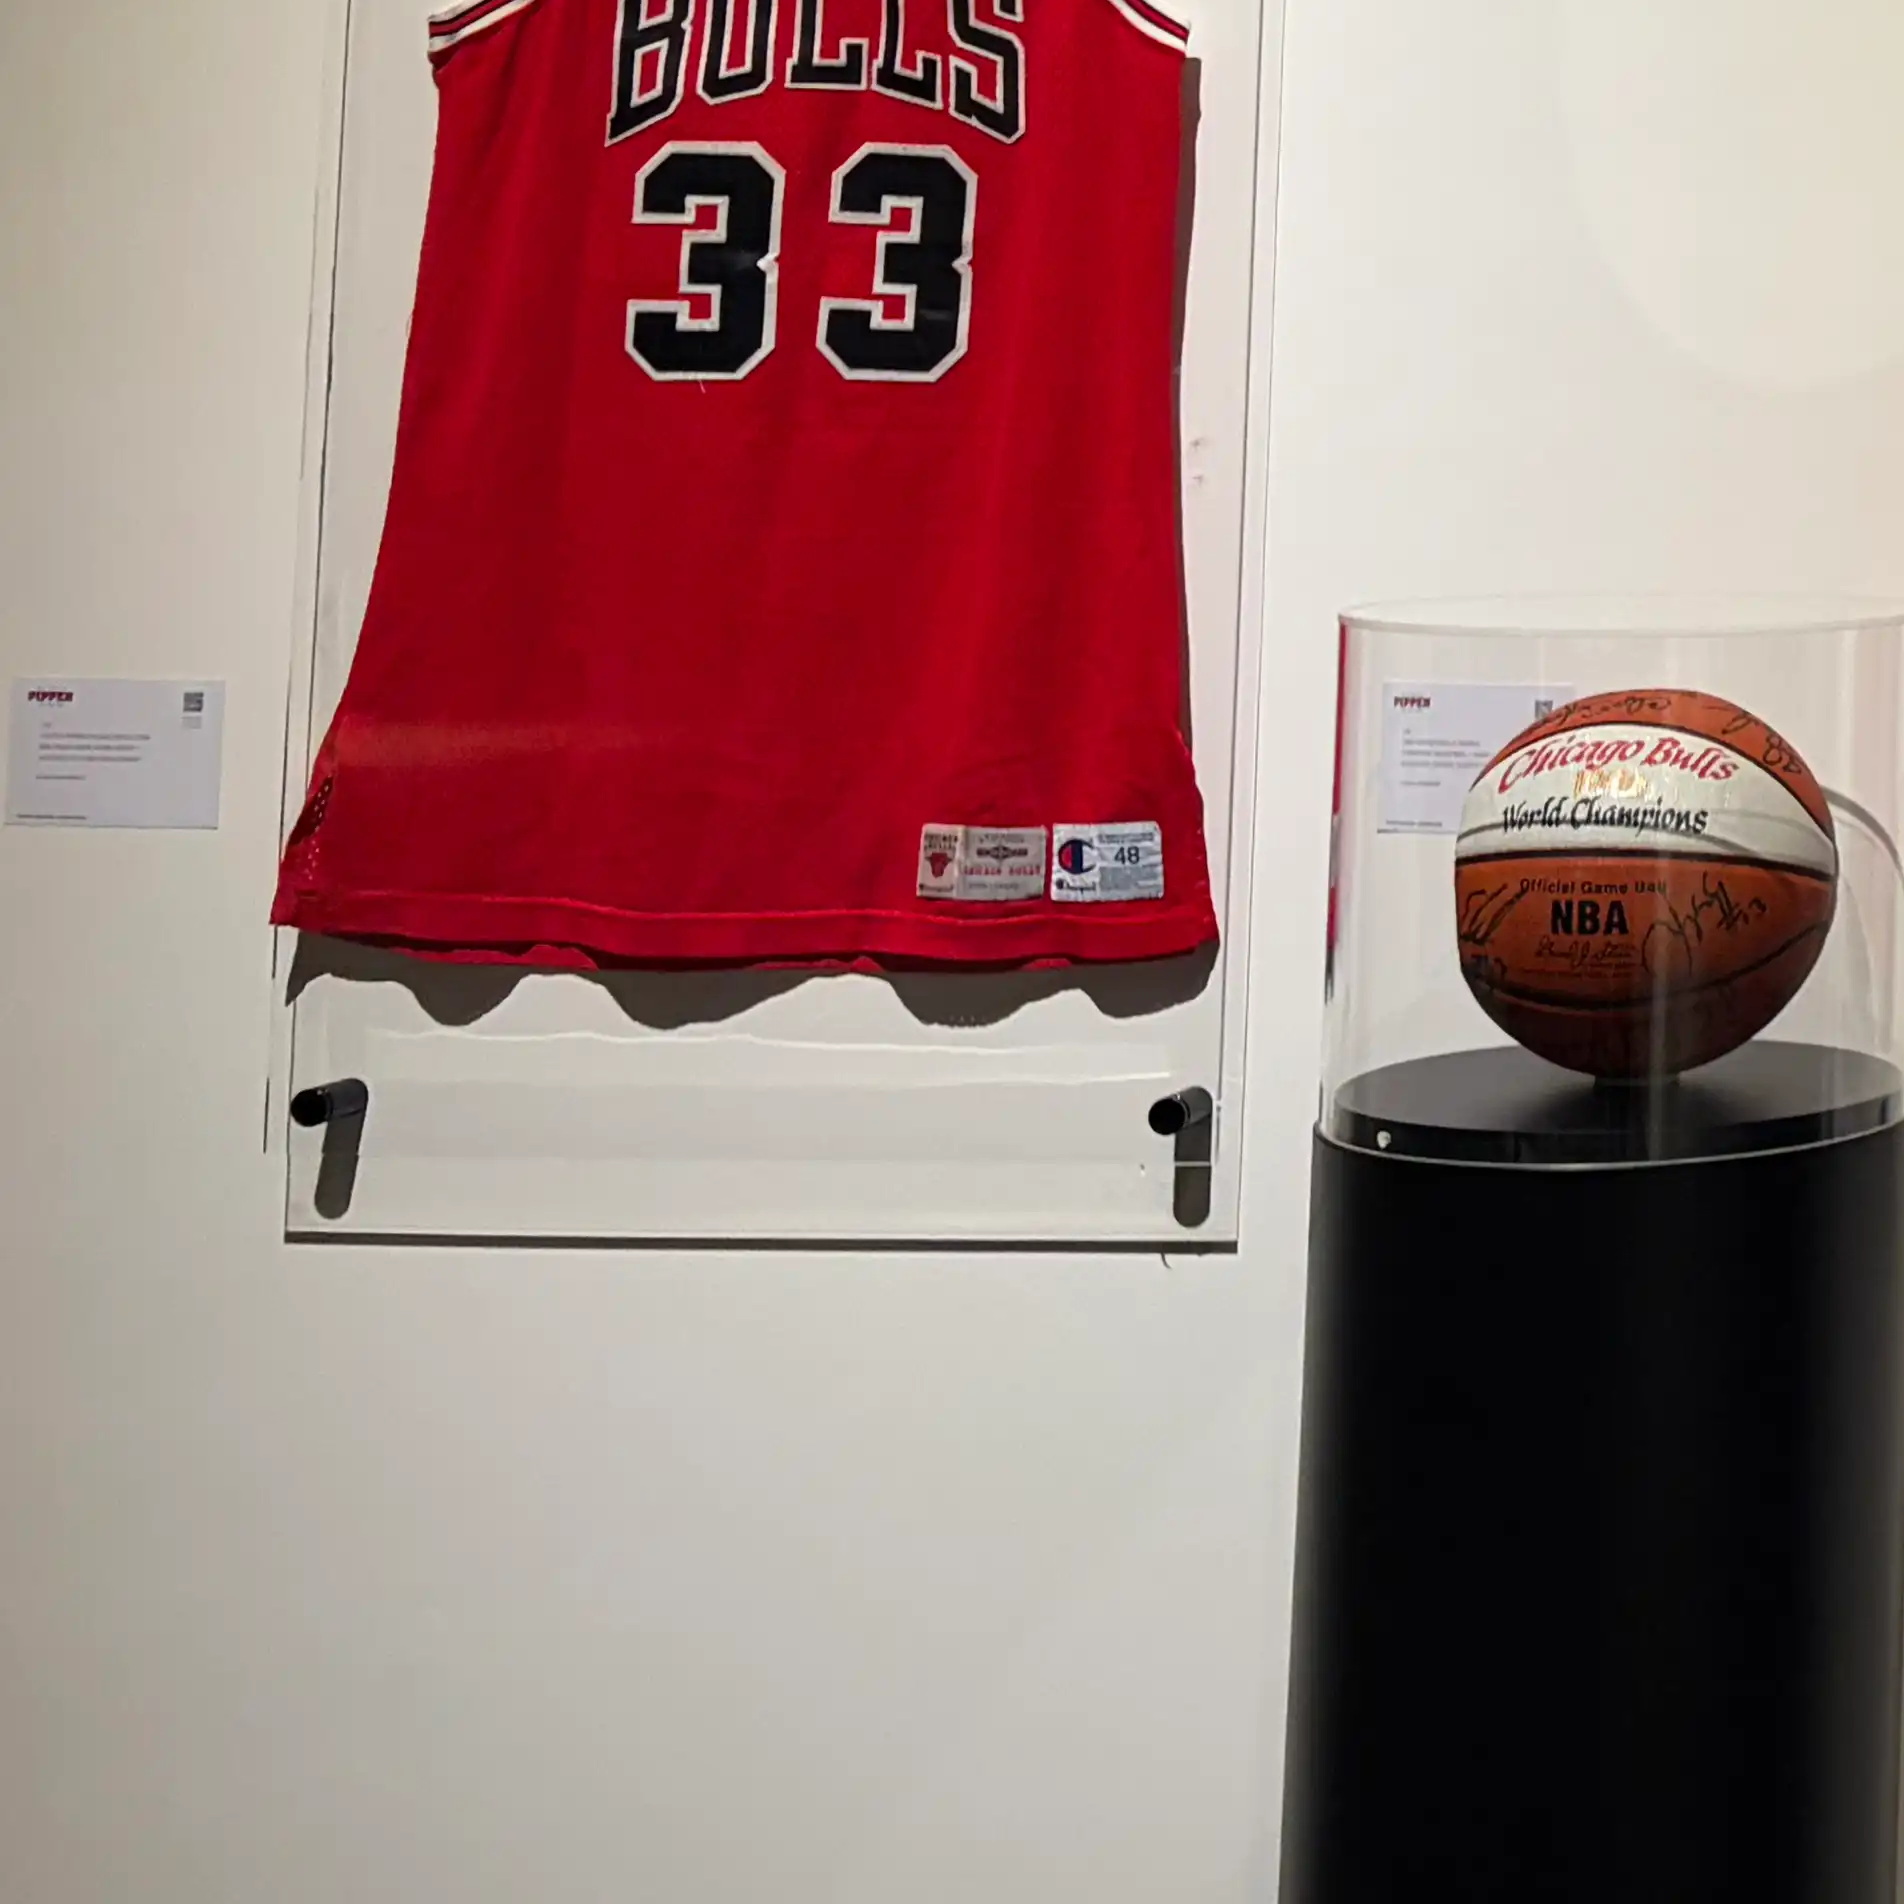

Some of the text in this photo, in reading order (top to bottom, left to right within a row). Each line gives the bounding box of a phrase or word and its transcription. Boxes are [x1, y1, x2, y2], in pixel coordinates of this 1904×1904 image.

[625, 141, 978, 382] 33
[1393, 696, 1431, 708] PIPPEN
[1498, 735, 1641, 794] Chicago
[1643, 737, 1739, 781] Bulls
[1502, 796, 1709, 837] World Champions
[1115, 846, 1140, 865] 48
[1520, 878, 1575, 894] Official
[1551, 899, 1629, 935] NBA
